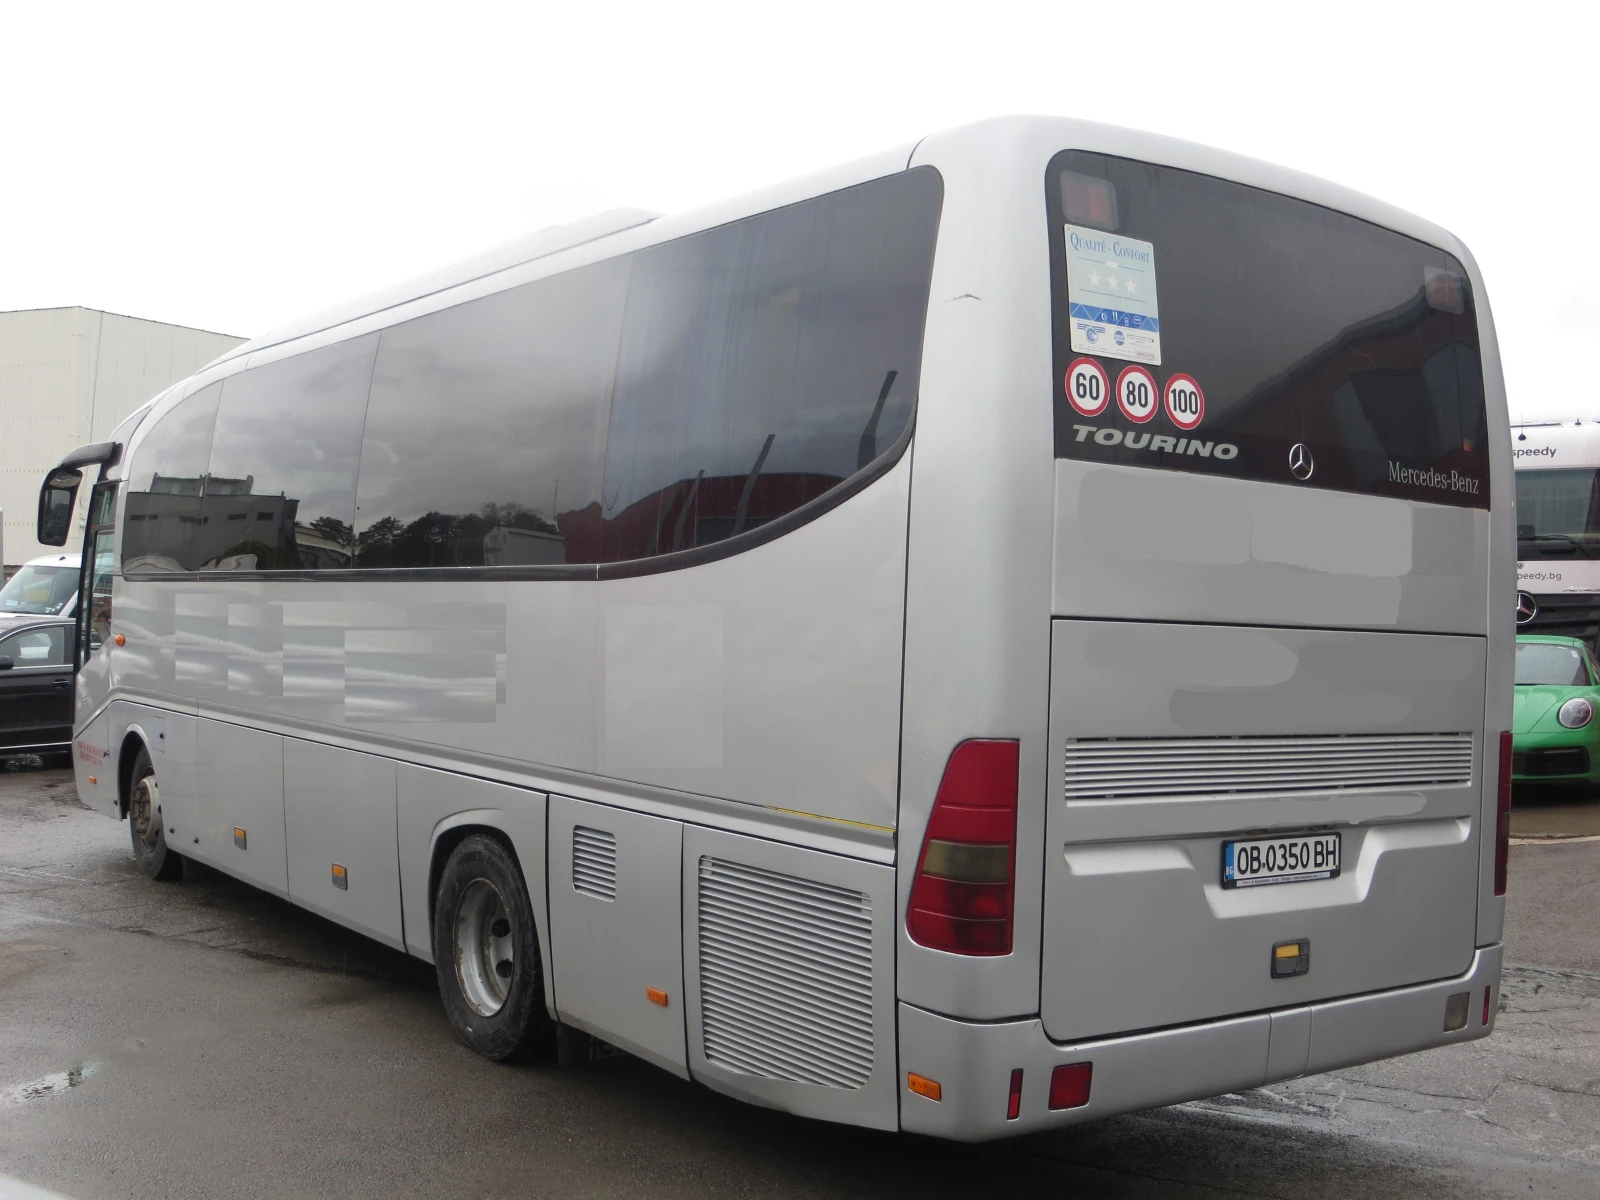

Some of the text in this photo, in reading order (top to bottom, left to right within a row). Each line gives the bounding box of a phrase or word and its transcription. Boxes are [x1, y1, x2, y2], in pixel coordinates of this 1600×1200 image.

[1113, 241, 1150, 263] CONFORT
[1075, 372, 1100, 401] 60
[1126, 380, 1149, 408] 80
[1171, 388, 1199, 415] 100
[1072, 424, 1239, 460] TOURINO
[1512, 446, 1557, 459] speedy
[1388, 460, 1479, 494] Mercedes-Benz
[1516, 572, 1562, 581] peedy.bg
[1225, 866, 1234, 876] BG
